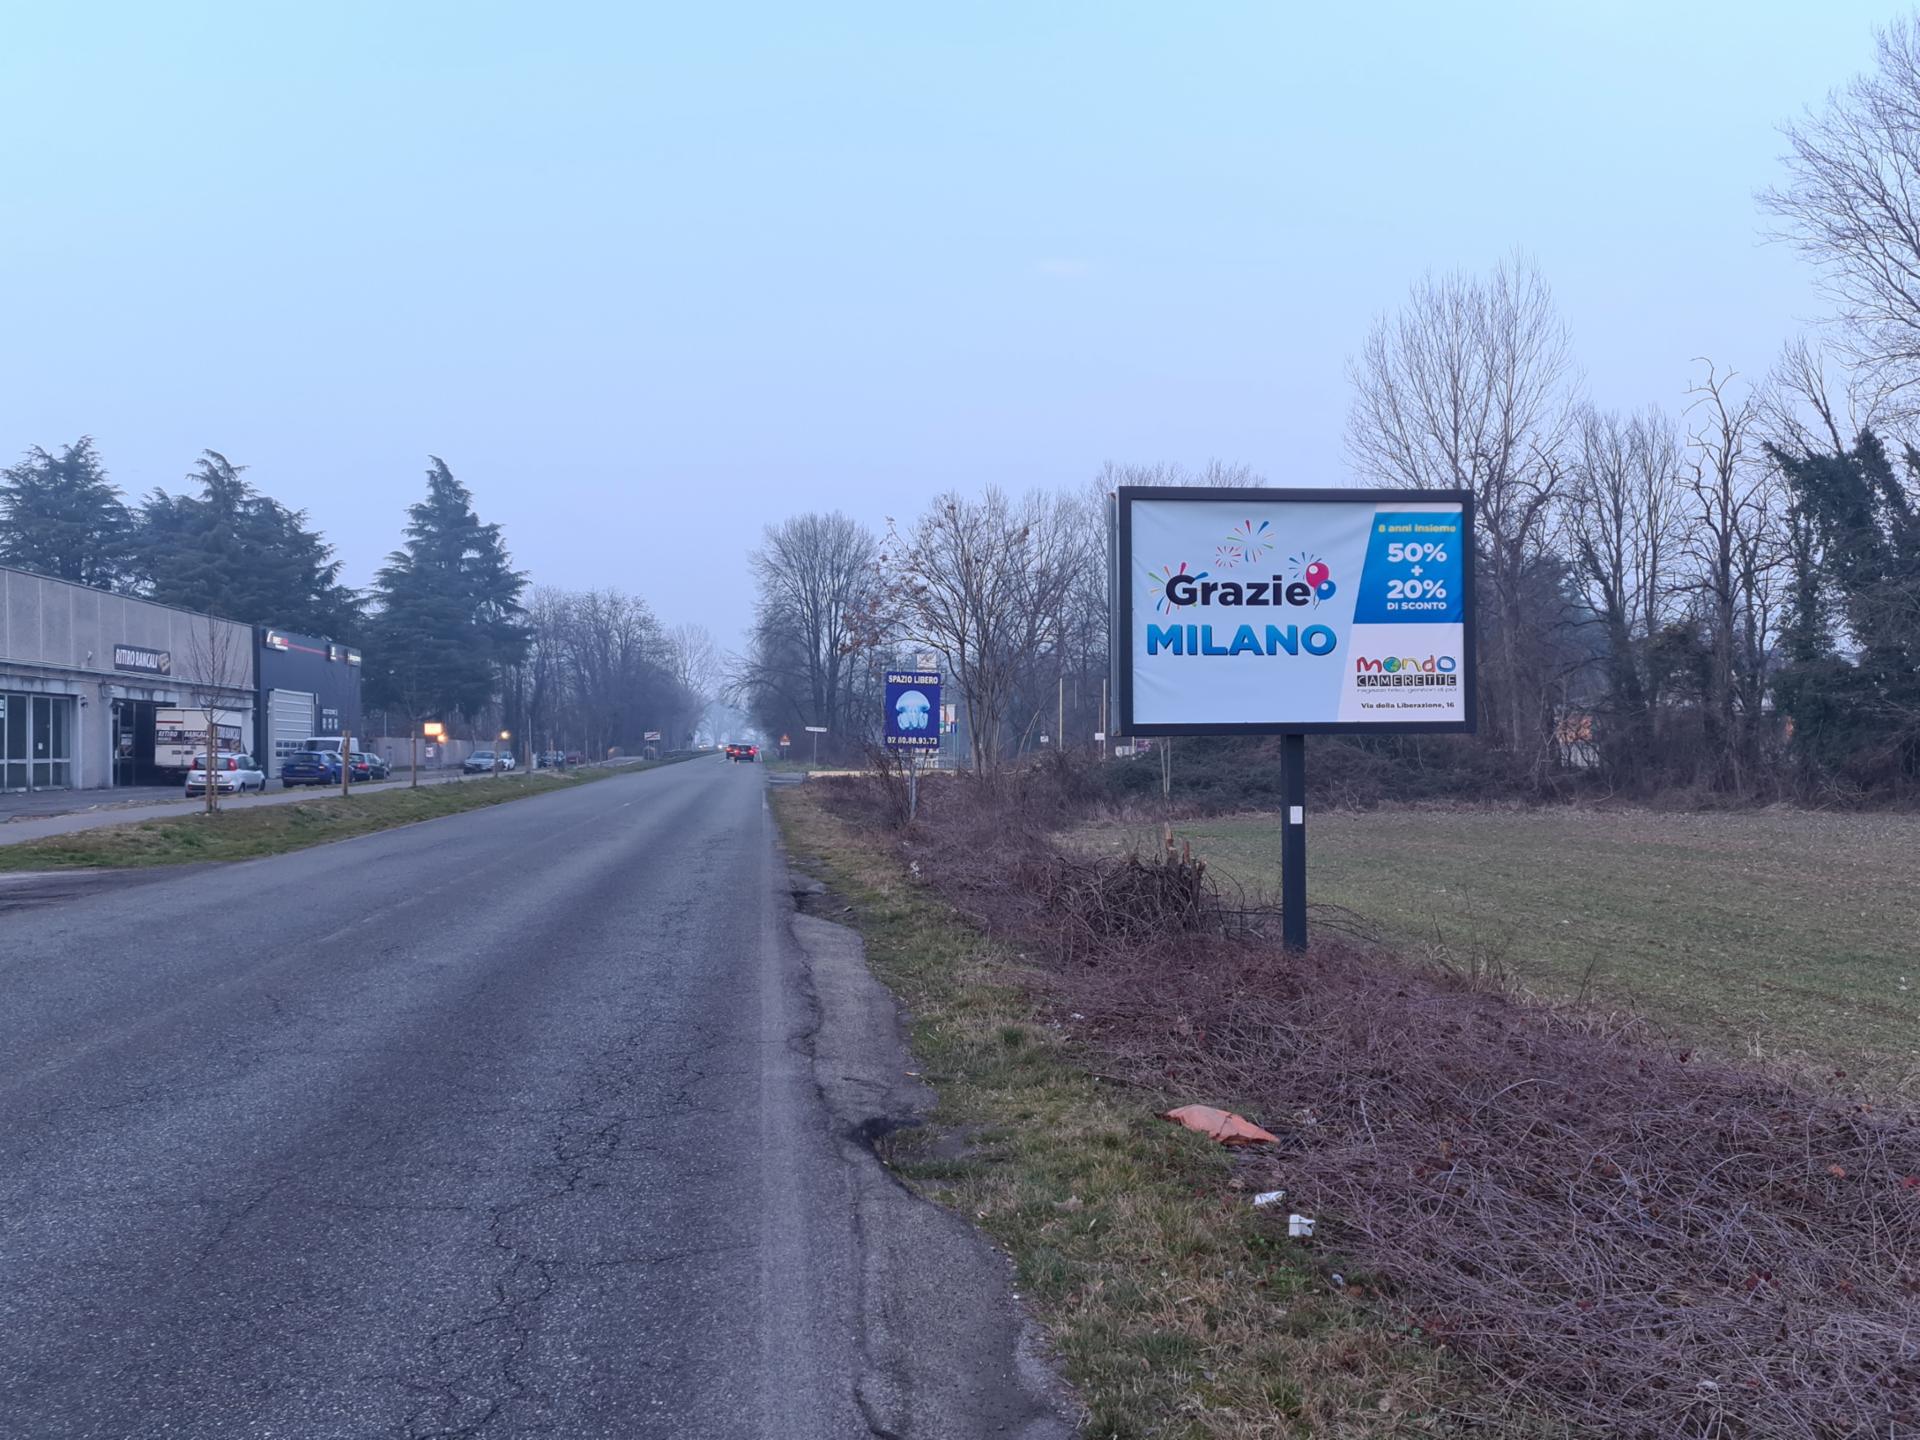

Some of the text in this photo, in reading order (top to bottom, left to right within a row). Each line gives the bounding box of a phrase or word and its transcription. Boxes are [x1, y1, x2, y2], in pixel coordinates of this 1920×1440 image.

[1388, 524, 1412, 533] anni
[1414, 524, 1457, 533] insieme
[1387, 542, 1448, 563] 50%
[1410, 564, 1424, 577] +
[1165, 574, 1311, 607] Grazie
[1386, 579, 1447, 599] 20%
[1387, 601, 1447, 610] DI SCONTO
[1147, 623, 1338, 657] MILANO
[115, 648, 158, 669] RITIRO BANCALI
[888, 675, 939, 685] SPAZIO LIBERO
[1357, 674, 1456, 687] CAMERETTE
[184, 730, 209, 738] BANCAL
[887, 736, 896, 744] 02
